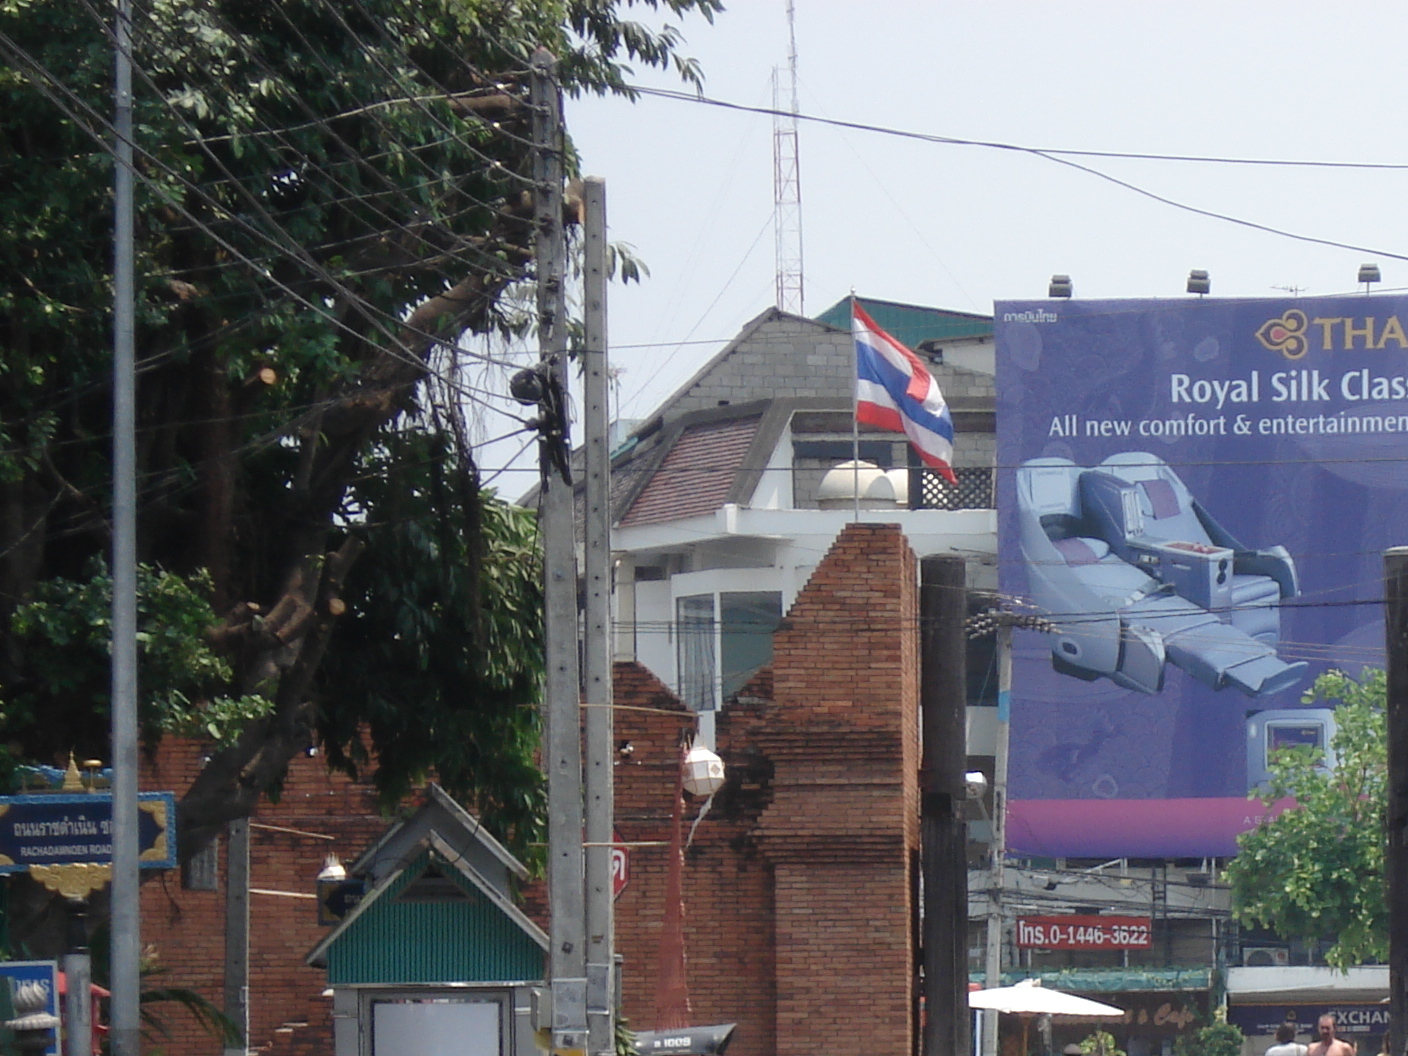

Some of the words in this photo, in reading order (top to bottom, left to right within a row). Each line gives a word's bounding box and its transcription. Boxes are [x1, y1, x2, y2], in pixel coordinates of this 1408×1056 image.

[1171, 370, 1259, 409] Royal
[1271, 369, 1331, 401] Silk
[1049, 415, 1077, 436] All
[1086, 419, 1132, 436] new
[1139, 413, 1227, 435] comfort
[1233, 415, 1252, 434] &
